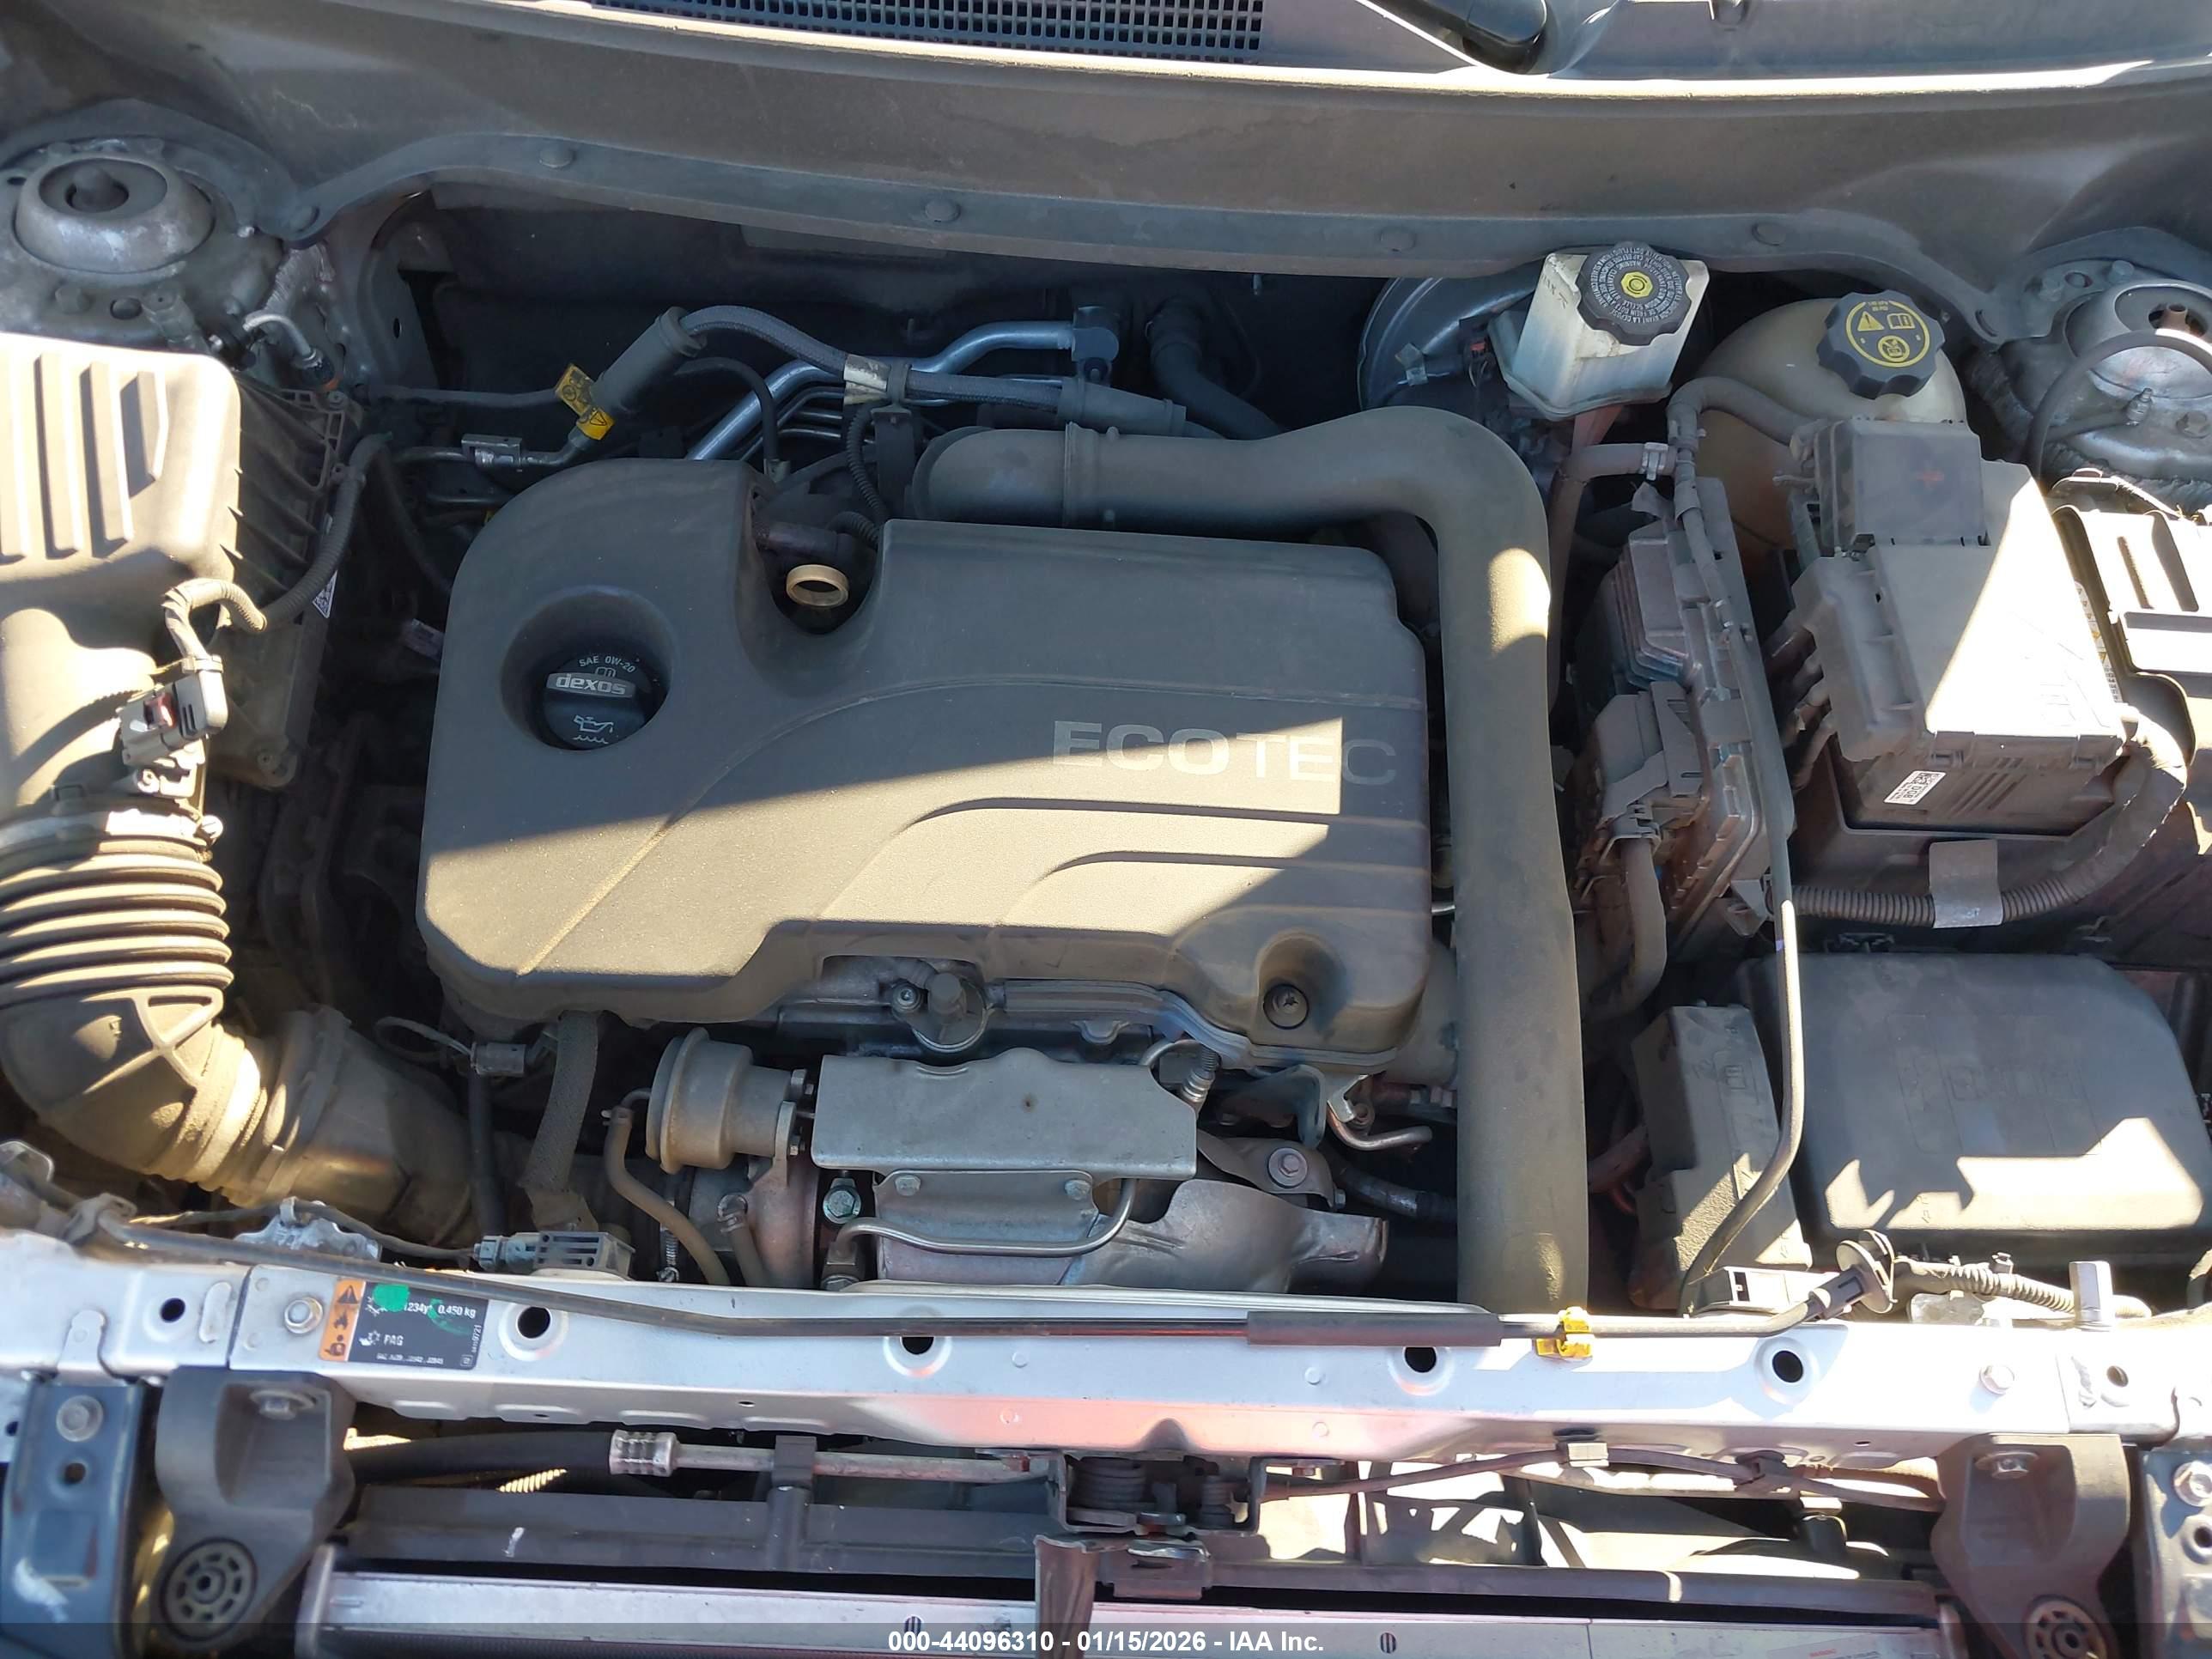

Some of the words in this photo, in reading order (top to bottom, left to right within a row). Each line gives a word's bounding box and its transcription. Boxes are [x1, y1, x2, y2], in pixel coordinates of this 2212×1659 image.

[579, 656, 599, 667] SAE
[605, 655, 635, 673] 0W-20
[556, 673, 626, 695] dexos
[1053, 720, 1396, 785] ECOTEC
[383, 1334, 404, 1346] PAG
